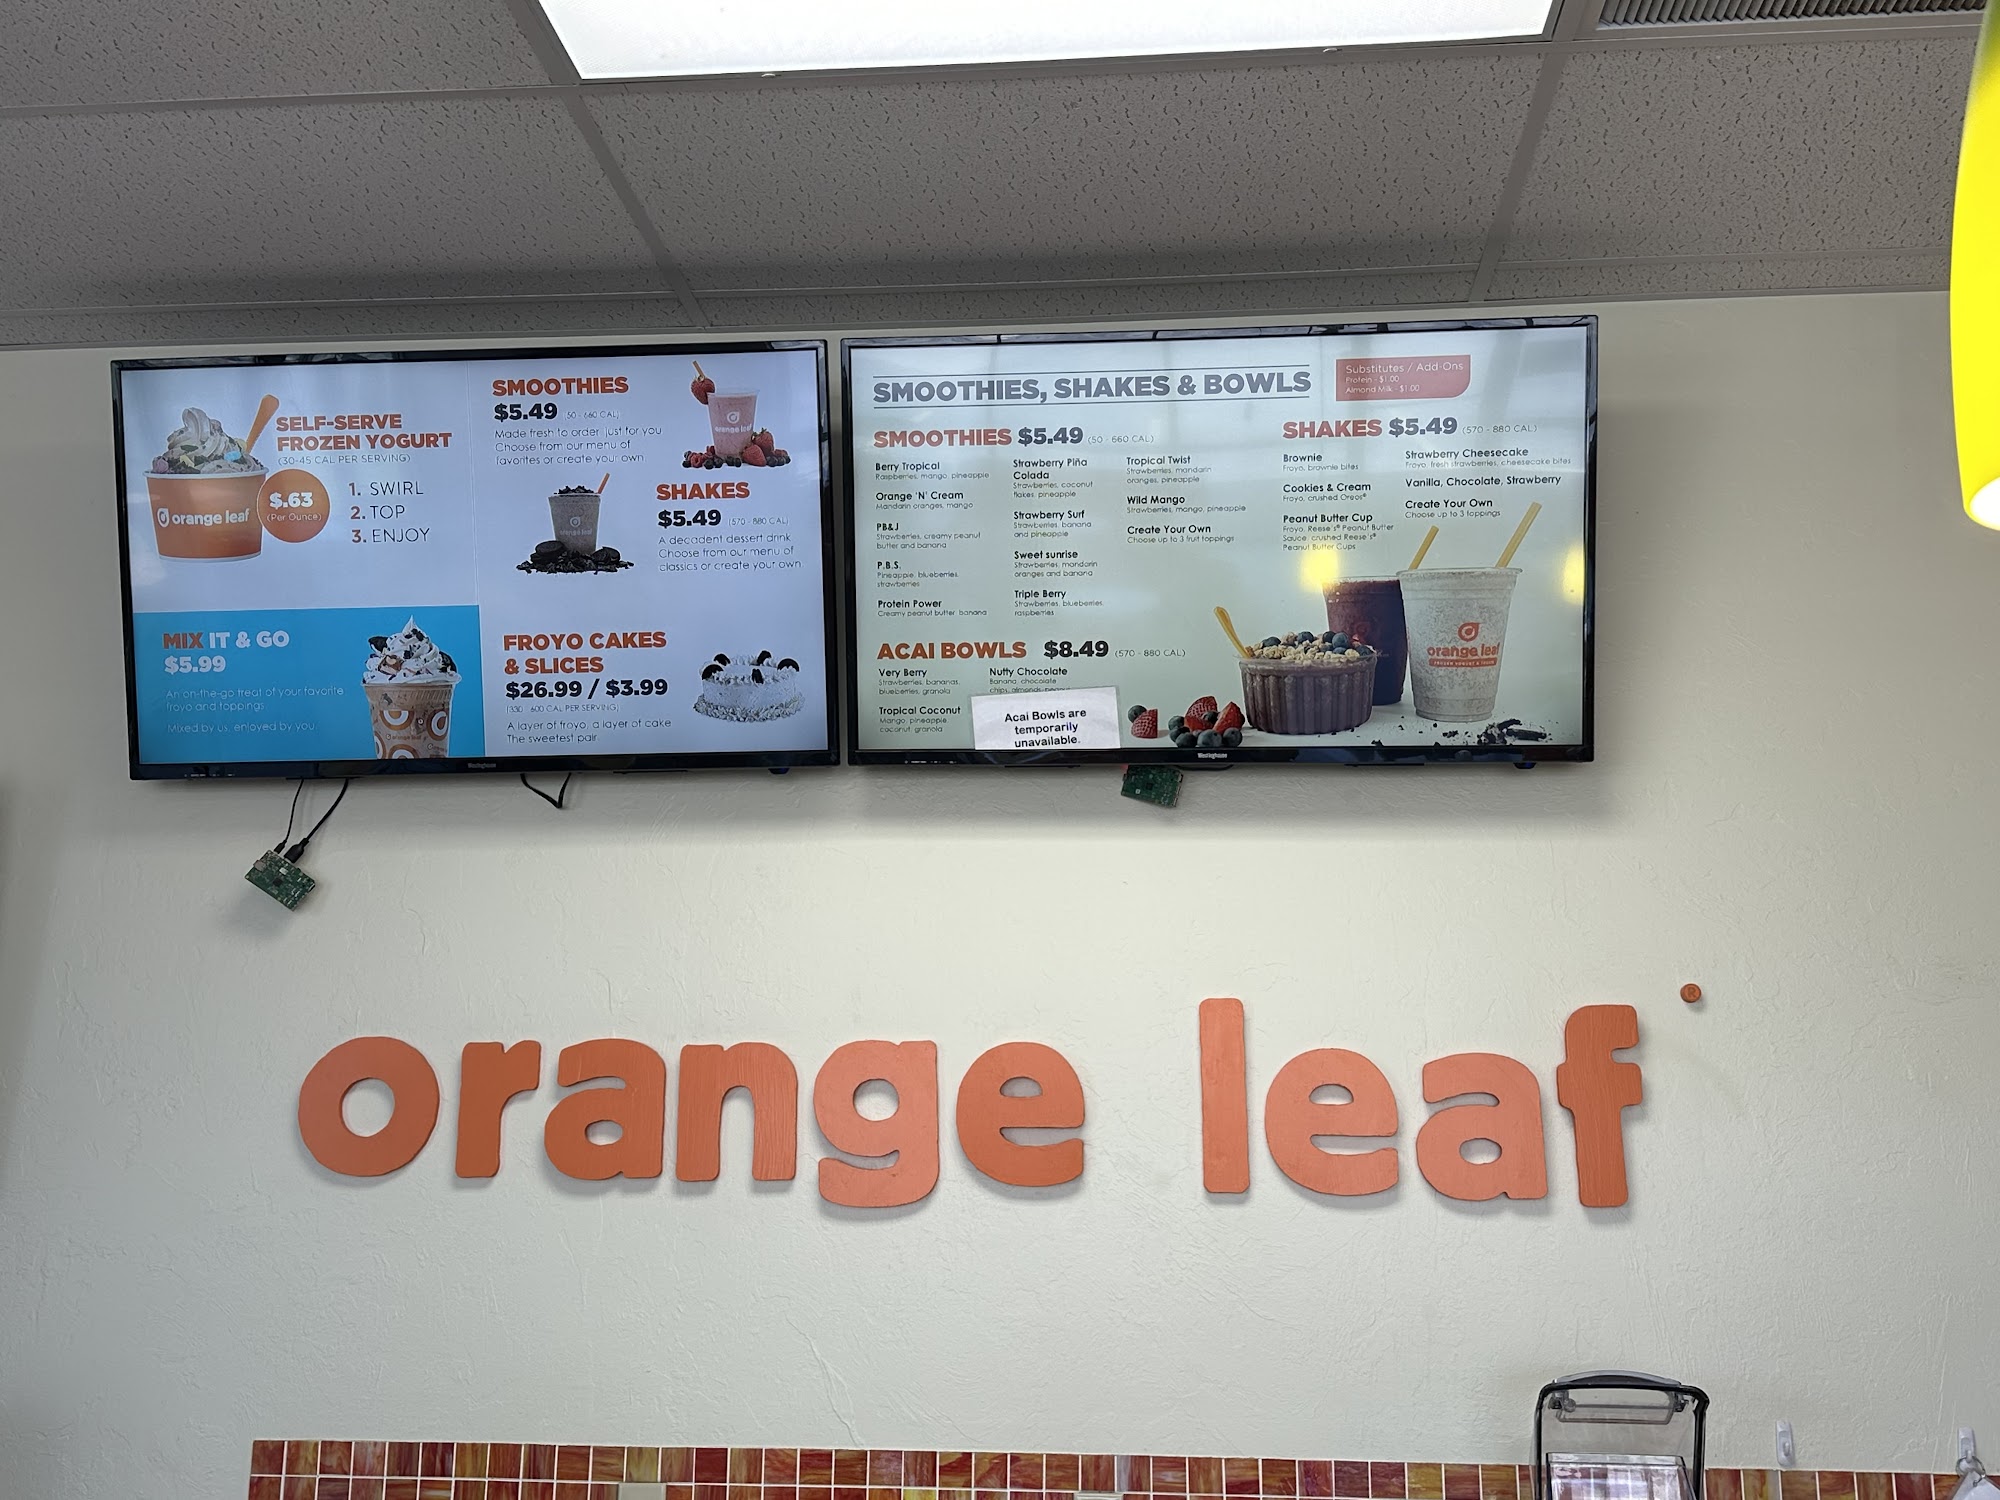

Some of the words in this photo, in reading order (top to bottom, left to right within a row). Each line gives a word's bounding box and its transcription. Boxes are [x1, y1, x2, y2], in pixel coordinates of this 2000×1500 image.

[1346, 364, 1404, 373] Substitutes
[1407, 362, 1413, 372] /
[1416, 362, 1463, 371] Add-Ons
[493, 377, 628, 396] SMOOTHIES
[873, 379, 1046, 403] SMOOTHIES,
[1054, 376, 1170, 398] SHAKES
[1177, 374, 1196, 395] &
[1205, 372, 1311, 394] BOWLS
[494, 402, 557, 422] $5.49
[277, 414, 402, 431] SELF-SERVE
[1389, 417, 1457, 437] $5.49
[495, 429, 526, 438] Made
[530, 428, 553, 437] fresh
[558, 428, 568, 436] to
[571, 427, 599, 436] order
[625, 426, 639, 435] for
[642, 427, 661, 436] you
[1283, 420, 1382, 438] SHAKES
[278, 435, 360, 451] FROZEN
[365, 432, 452, 449] YOGURT
[874, 429, 1012, 447] SMOOTHIES
[1018, 427, 1083, 446] $5.49
[495, 442, 536, 452] Choose
[539, 441, 562, 450] from
[620, 440, 630, 448] of
[338, 455, 357, 463] PER
[1283, 453, 1322, 462] Brownie
[1406, 450, 1459, 459] Strawberry
[1462, 447, 1528, 457] Cheesecake
[1013, 459, 1064, 468] Strawberry
[1067, 458, 1087, 466] Piña
[1126, 456, 1165, 466] Tropical
[1168, 455, 1190, 464] Twist
[875, 462, 899, 472] Berry
[902, 462, 939, 472] Tropical
[1013, 470, 1049, 479] Colada
[1283, 483, 1323, 492] Cookies
[1336, 482, 1370, 491] Cream
[1406, 478, 1443, 487] Vanilla,
[1446, 476, 1503, 486] Chocolate,
[1506, 475, 1561, 485] Strawberry
[348, 482, 361, 496] 1.
[370, 481, 424, 496] SWIRL
[657, 482, 749, 500] SHAKES
[270, 492, 313, 509] $.63
[875, 492, 912, 502] Orange
[930, 491, 963, 499] Cream
[1127, 495, 1147, 504] Wild
[1150, 495, 1185, 505] Mango
[1405, 499, 1440, 508] Create
[1443, 499, 1466, 507] Your
[1469, 498, 1492, 507] Own
[172, 514, 222, 526] orange
[226, 509, 249, 523] leaf
[350, 506, 365, 519] 2.
[369, 505, 404, 519] TOP
[1014, 510, 1064, 520] Strawberry
[1067, 510, 1084, 518] Surf
[658, 509, 721, 528] $5.49
[1283, 514, 1317, 523] Peanut
[1320, 513, 1348, 525] Butter
[1351, 513, 1374, 524] Cup
[876, 522, 898, 531] PB&J
[1127, 525, 1160, 534] Create
[1163, 525, 1186, 533] Your
[1188, 524, 1210, 533] Own
[352, 529, 366, 543] 3.
[372, 528, 429, 542] ENJOY
[659, 549, 699, 558] Choose
[703, 548, 726, 557] from
[783, 545, 793, 554] of
[1014, 550, 1043, 559] Sweet
[1045, 550, 1078, 558] sunrise
[877, 561, 901, 569] P.B.S.
[1014, 590, 1039, 599] Triple
[1042, 589, 1066, 599] Berry
[878, 599, 909, 608] Protein
[913, 599, 942, 607] Power
[164, 632, 203, 649] MIX
[209, 632, 230, 648] IT
[235, 631, 250, 648] &
[256, 630, 289, 647] GO
[504, 633, 583, 650] FROYO
[589, 632, 666, 648] CAKES
[877, 643, 934, 659] ACAI
[941, 642, 1026, 658] BOWLS
[1044, 640, 1108, 659] $8.49
[1427, 646, 1479, 658] orange
[1481, 642, 1500, 656] leaf
[165, 655, 225, 674] $5.99
[504, 659, 519, 674] &
[525, 657, 603, 674] SLICES
[878, 668, 900, 678] Very
[904, 668, 927, 677] Berry
[989, 667, 1014, 677] Nutty
[1017, 667, 1067, 675] Chocolate
[505, 680, 582, 700] $26.99
[587, 679, 600, 699] /
[606, 678, 667, 698] $3.99
[879, 706, 916, 716] Tropical
[919, 706, 960, 714] Coconut
[1004, 712, 1029, 722] Acai
[1032, 710, 1065, 720] Bowls
[1068, 710, 1086, 718] are
[507, 722, 514, 730] A
[518, 722, 543, 731] layer
[546, 721, 556, 729] of
[603, 720, 627, 729] layer
[631, 719, 641, 727] of
[645, 718, 671, 727] cake
[1014, 723, 1078, 735] temporarily
[507, 734, 525, 743] The
[528, 733, 573, 743] sweetest
[298, 1036, 1085, 1208] orange
[1199, 998, 1643, 1207] leaf
